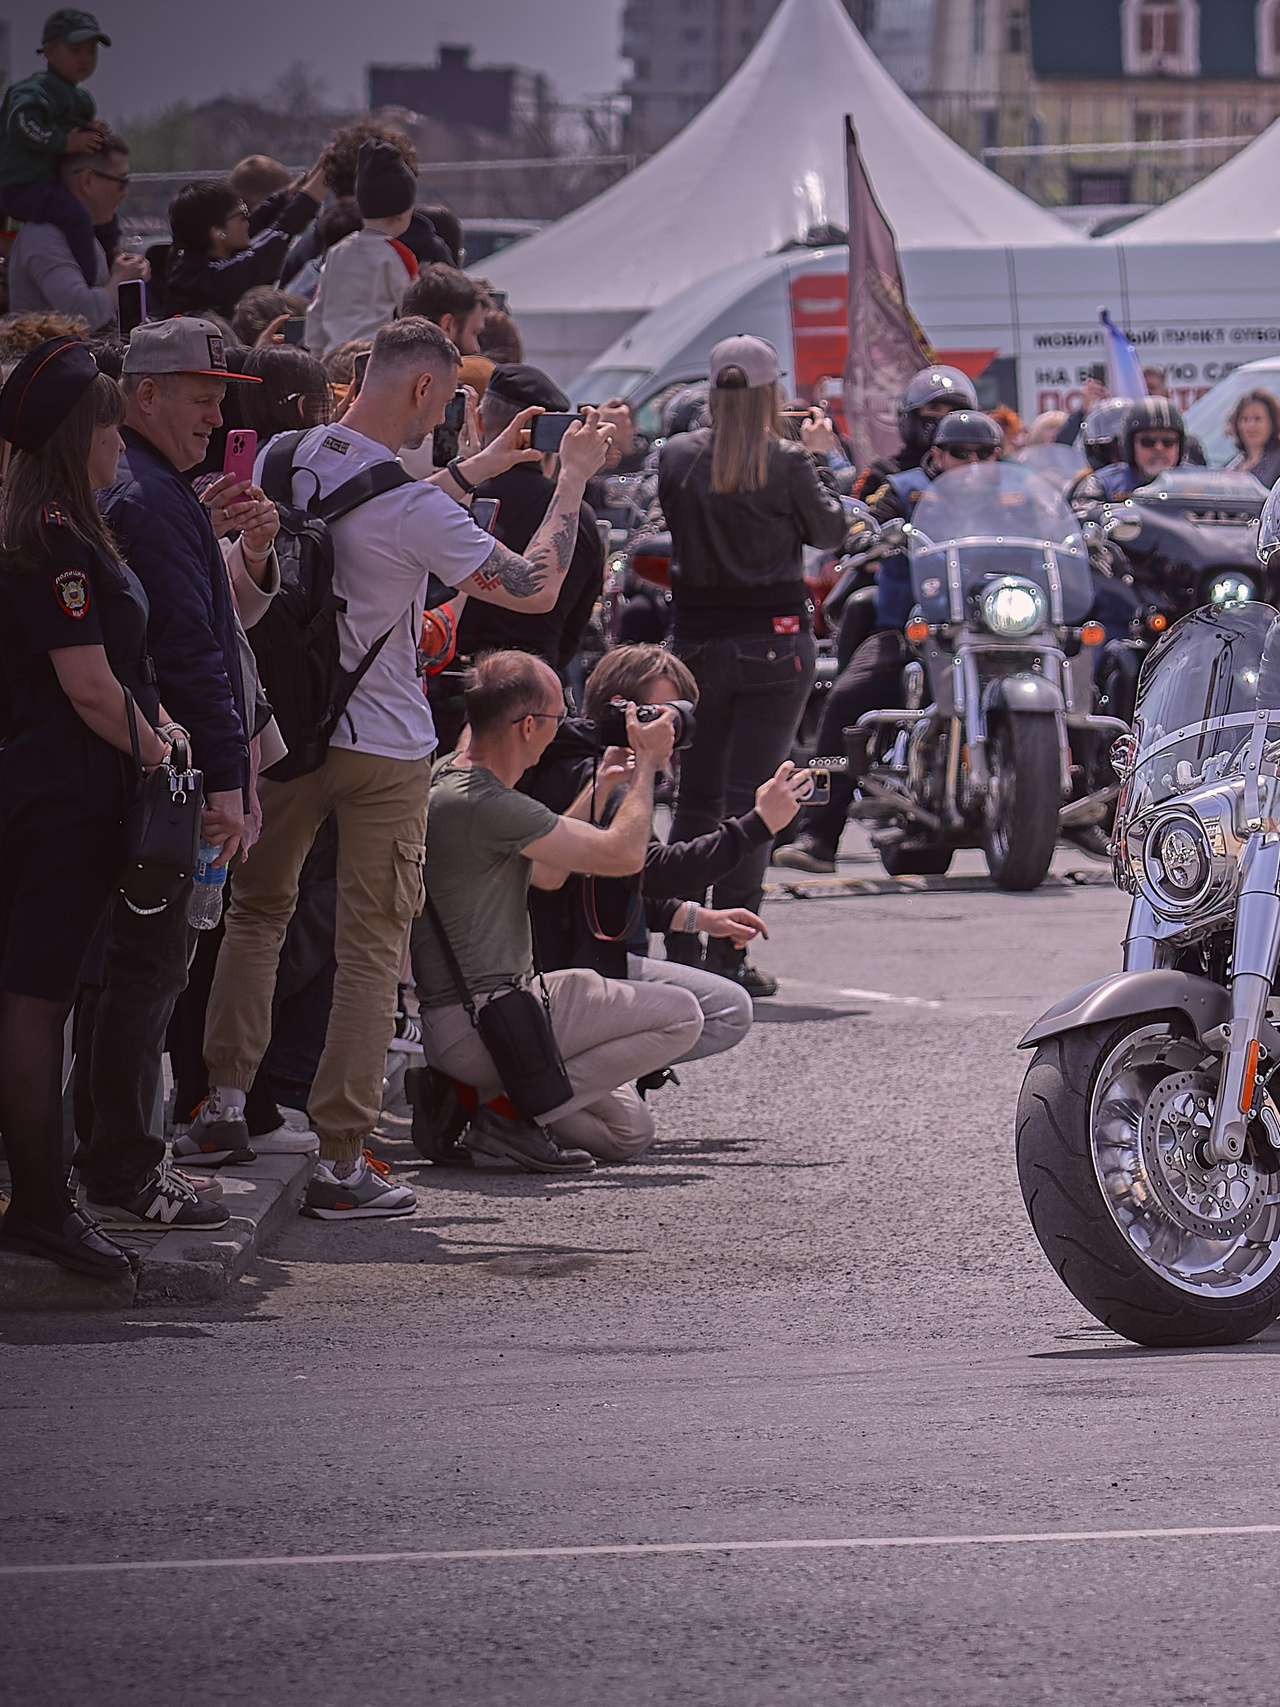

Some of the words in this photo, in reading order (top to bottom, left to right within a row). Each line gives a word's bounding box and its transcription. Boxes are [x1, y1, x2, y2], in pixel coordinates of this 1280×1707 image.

[1035, 366, 1071, 385] НА
[55, 570, 86, 585] ПОЛИЦИЯ
[144, 1194, 184, 1224] N
